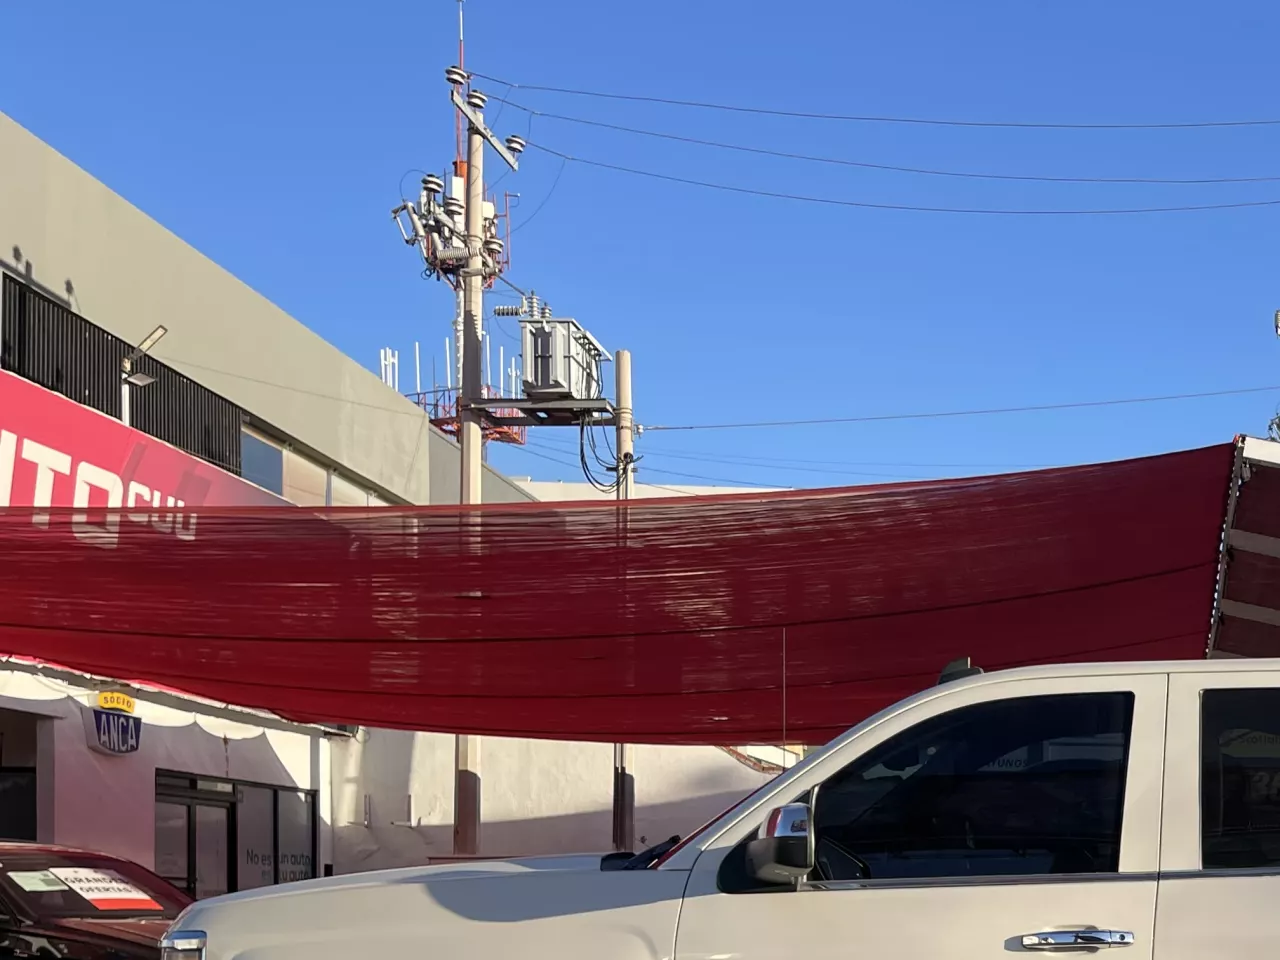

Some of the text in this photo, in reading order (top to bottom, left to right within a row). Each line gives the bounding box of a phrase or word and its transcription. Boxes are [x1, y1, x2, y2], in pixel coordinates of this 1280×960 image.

[103, 696, 132, 708] SOCIO
[101, 713, 137, 752] ANCA
[246, 849, 259, 865] No
[261, 853, 272, 867] es
[290, 852, 311, 866] auto
